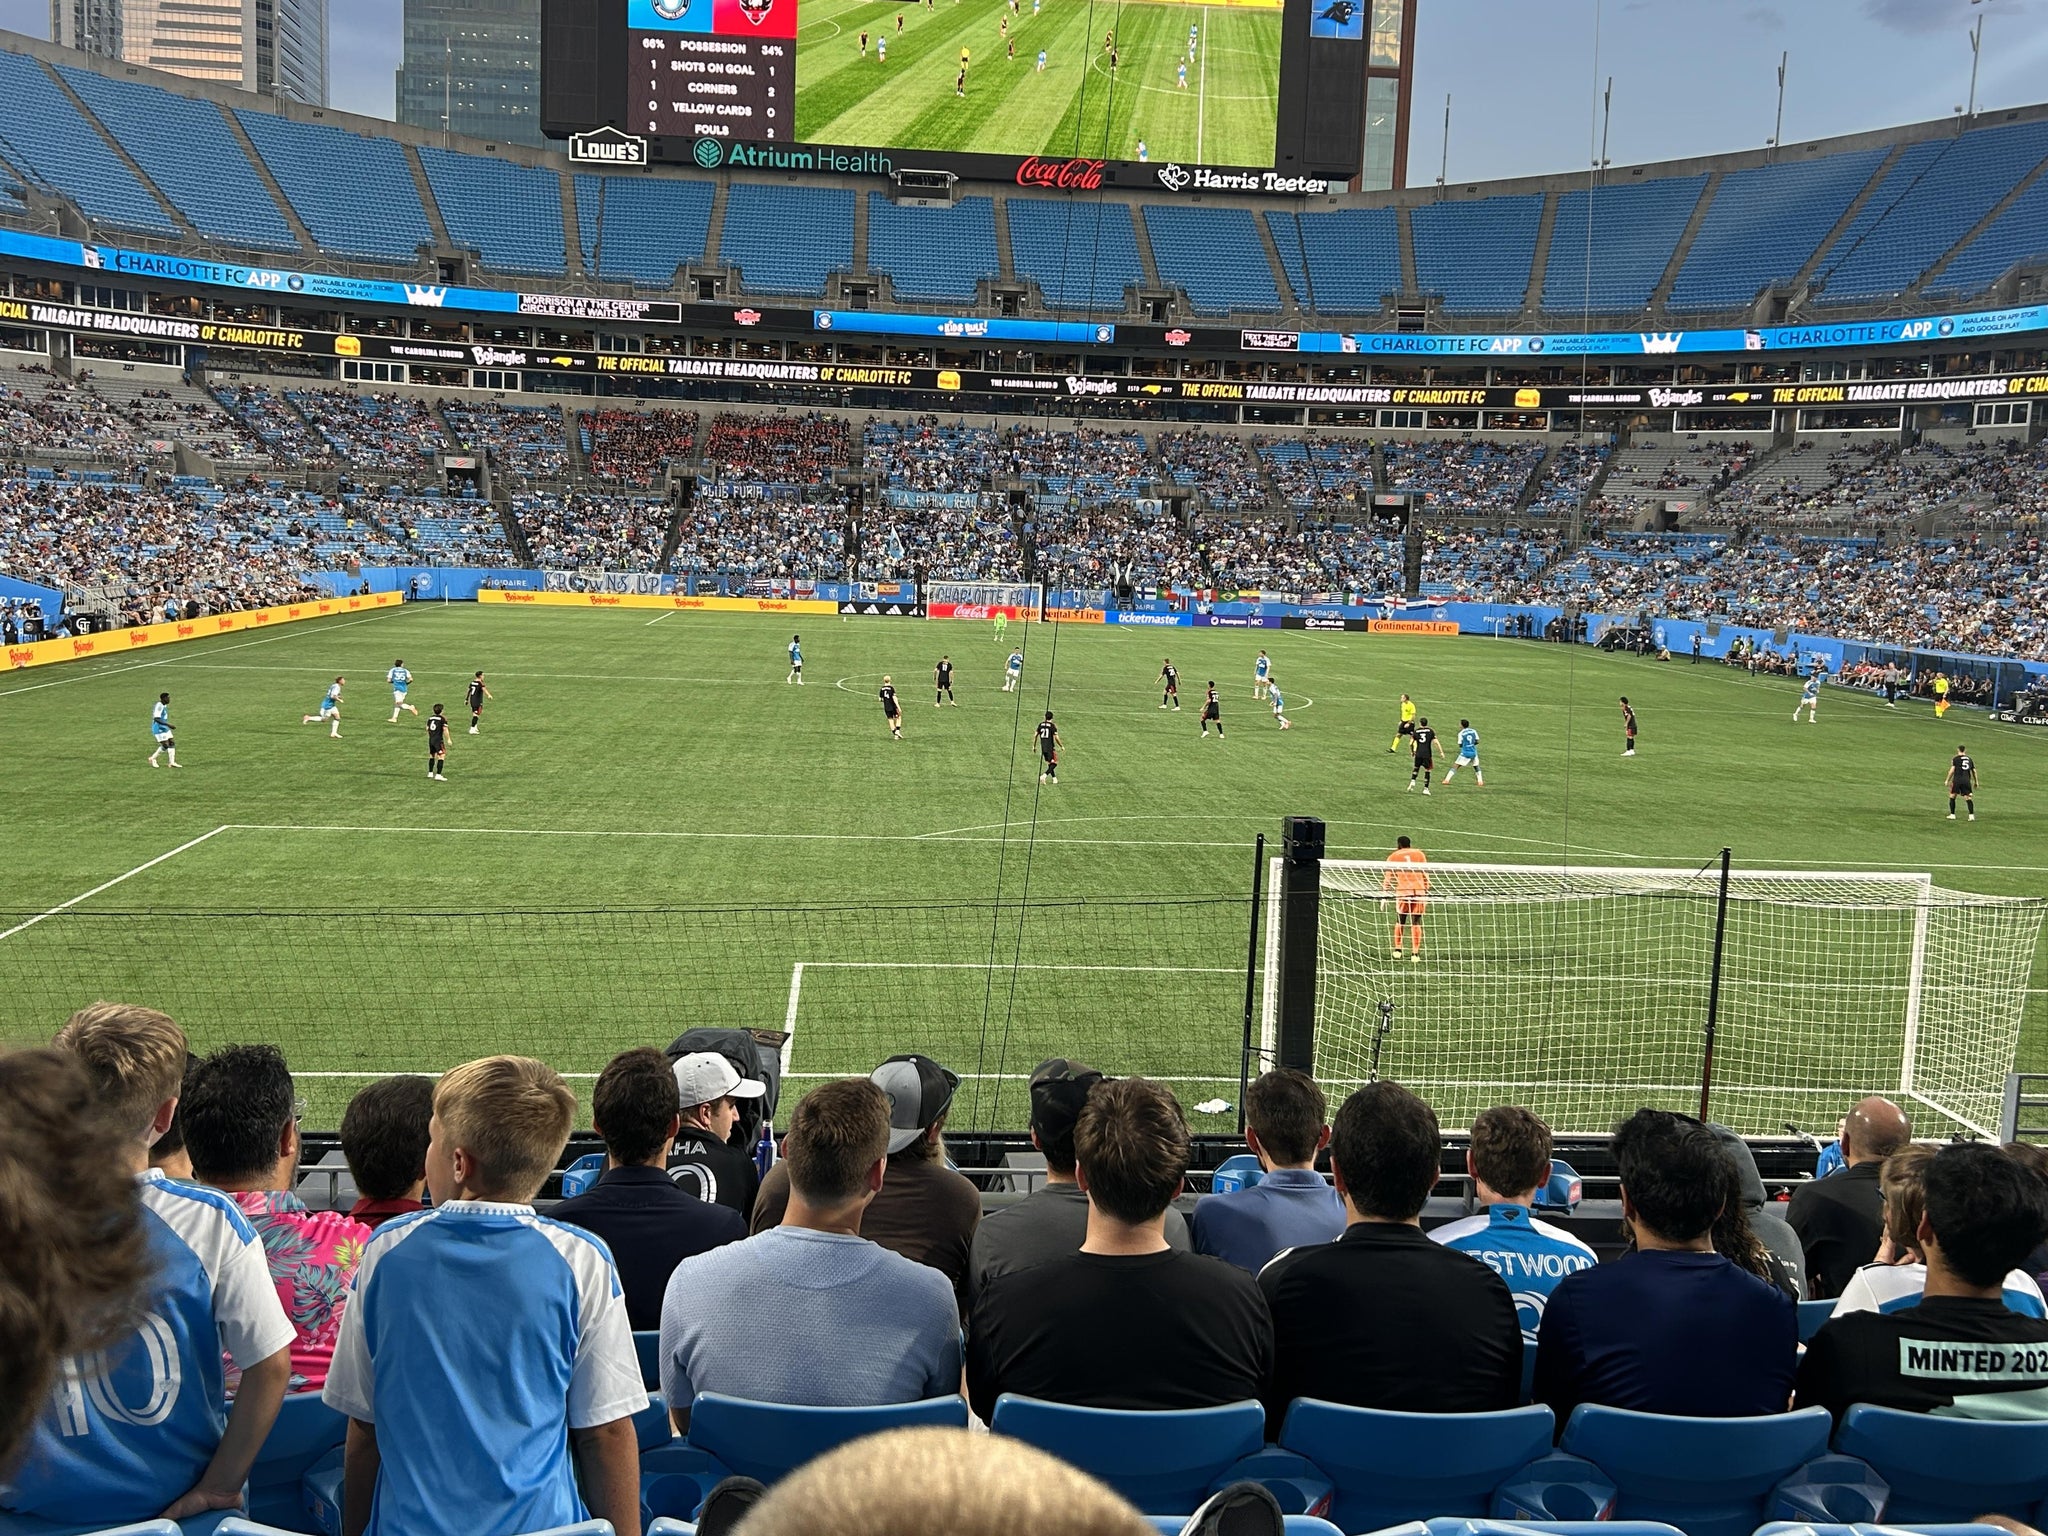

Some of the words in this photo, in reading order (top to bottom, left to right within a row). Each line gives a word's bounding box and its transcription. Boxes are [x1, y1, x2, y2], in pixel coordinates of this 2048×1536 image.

[642, 38, 665, 49] 66%
[680, 40, 747, 54] POSSESSION
[761, 45, 783, 56] 34%
[650, 59, 657, 69] 1
[671, 60, 706, 72] SHOTS
[708, 63, 724, 74] ON
[725, 64, 756, 75] GOAL
[769, 66, 775, 76] 1
[650, 79, 656, 90] 1
[687, 82, 738, 95] CORNERS
[767, 87, 775, 97] 2
[648, 100, 658, 111] 0
[672, 102, 715, 115] YELLOW
[717, 104, 752, 116] CARDS
[766, 107, 776, 118] 0
[649, 121, 657, 131] 3
[694, 124, 729, 136] FOULS
[767, 128, 775, 138] 2
[576, 141, 640, 162] LOWE'S
[728, 144, 813, 170] Atrium
[817, 148, 892, 173] Health
[1194, 169, 1259, 191] Harris
[1262, 172, 1328, 194] Teeter
[116, 254, 220, 281] CHARLOTTE
[225, 269, 245, 284] FC
[247, 271, 281, 288] APP
[312, 278, 346, 288] AVAILABLE
[327, 288, 355, 296] GOOGLE
[520, 303, 556, 314] CIRCLE
[558, 305, 571, 315] AS
[573, 306, 586, 316] HE
[586, 307, 619, 317] WAITS
[620, 308, 640, 318] FOR
[522, 296, 574, 307] MORRISON
[575, 299, 589, 308] AT
[591, 300, 611, 310] THE
[613, 301, 650, 312] CENTER
[31, 305, 92, 327] TAILGATE
[94, 313, 199, 339] HEADQUARTERS
[201, 325, 215, 340] OF
[218, 327, 286, 347] CHARLOTTE
[287, 333, 304, 348] FC
[1778, 326, 1876, 346] CHARLOTTE
[1878, 324, 1900, 341] FC
[1901, 321, 1933, 339] APP
[390, 345, 403, 354] THE
[404, 347, 438, 357] CAROLINA
[438, 349, 464, 359] LEGEND
[1371, 337, 1464, 351] CHARLOTTE
[1470, 338, 1488, 351] FC
[1489, 337, 1522, 352] APP
[471, 346, 526, 366] Bojangles
[597, 356, 617, 370] THE
[620, 356, 665, 373] OFFICIAL
[668, 360, 722, 375] TAILGATE
[724, 364, 818, 380] HEADQUARTERS
[820, 367, 834, 381] OF
[835, 368, 896, 384] CHARLOTTE
[897, 371, 912, 385] FC
[990, 379, 1001, 387] THE
[1003, 379, 1034, 388] CAROLINA
[1065, 376, 1117, 395] Bojangles
[1773, 388, 1795, 403] THE
[1797, 387, 1844, 402] OFFICIAL
[1847, 384, 1906, 401] TAILGATE
[1908, 379, 2007, 400] HEADQUARTERS
[2009, 377, 2026, 393] OF
[1182, 383, 1200, 397] THE
[1202, 384, 1243, 398] OFFICIAL
[1246, 385, 1296, 400] TAILGATE
[1297, 387, 1391, 403] HEADQUARTERS
[1392, 389, 1407, 403] OF
[1408, 390, 1469, 404] CHARLOTTE
[1470, 390, 1486, 404] FC
[1569, 394, 1581, 402] THE
[1582, 394, 1614, 403] CAROLINA
[1615, 394, 1641, 402] LEGEND
[1648, 387, 1703, 407] Bojangles
[702, 484, 729, 499] BLUE
[733, 484, 763, 500] FURIA
[637, 574, 660, 593] UP
[504, 592, 535, 602] Bojangles
[590, 595, 620, 605] Bojangles
[674, 598, 704, 608] Bojangles
[758, 600, 787, 610] Bojangles
[1080, 610, 1100, 620] Tire
[1118, 612, 1180, 625] ticketmaster
[1374, 621, 1423, 632] Continental
[1433, 622, 1452, 632] Tire
[393, 672, 406, 681] 35
[430, 720, 437, 731] 6
[1040, 728, 1049, 738] 21
[1419, 733, 1426, 743] 3
[1466, 735, 1473, 744] 9
[1961, 760, 1970, 770] 5
[1908, 1346, 2005, 1373] MINTED
